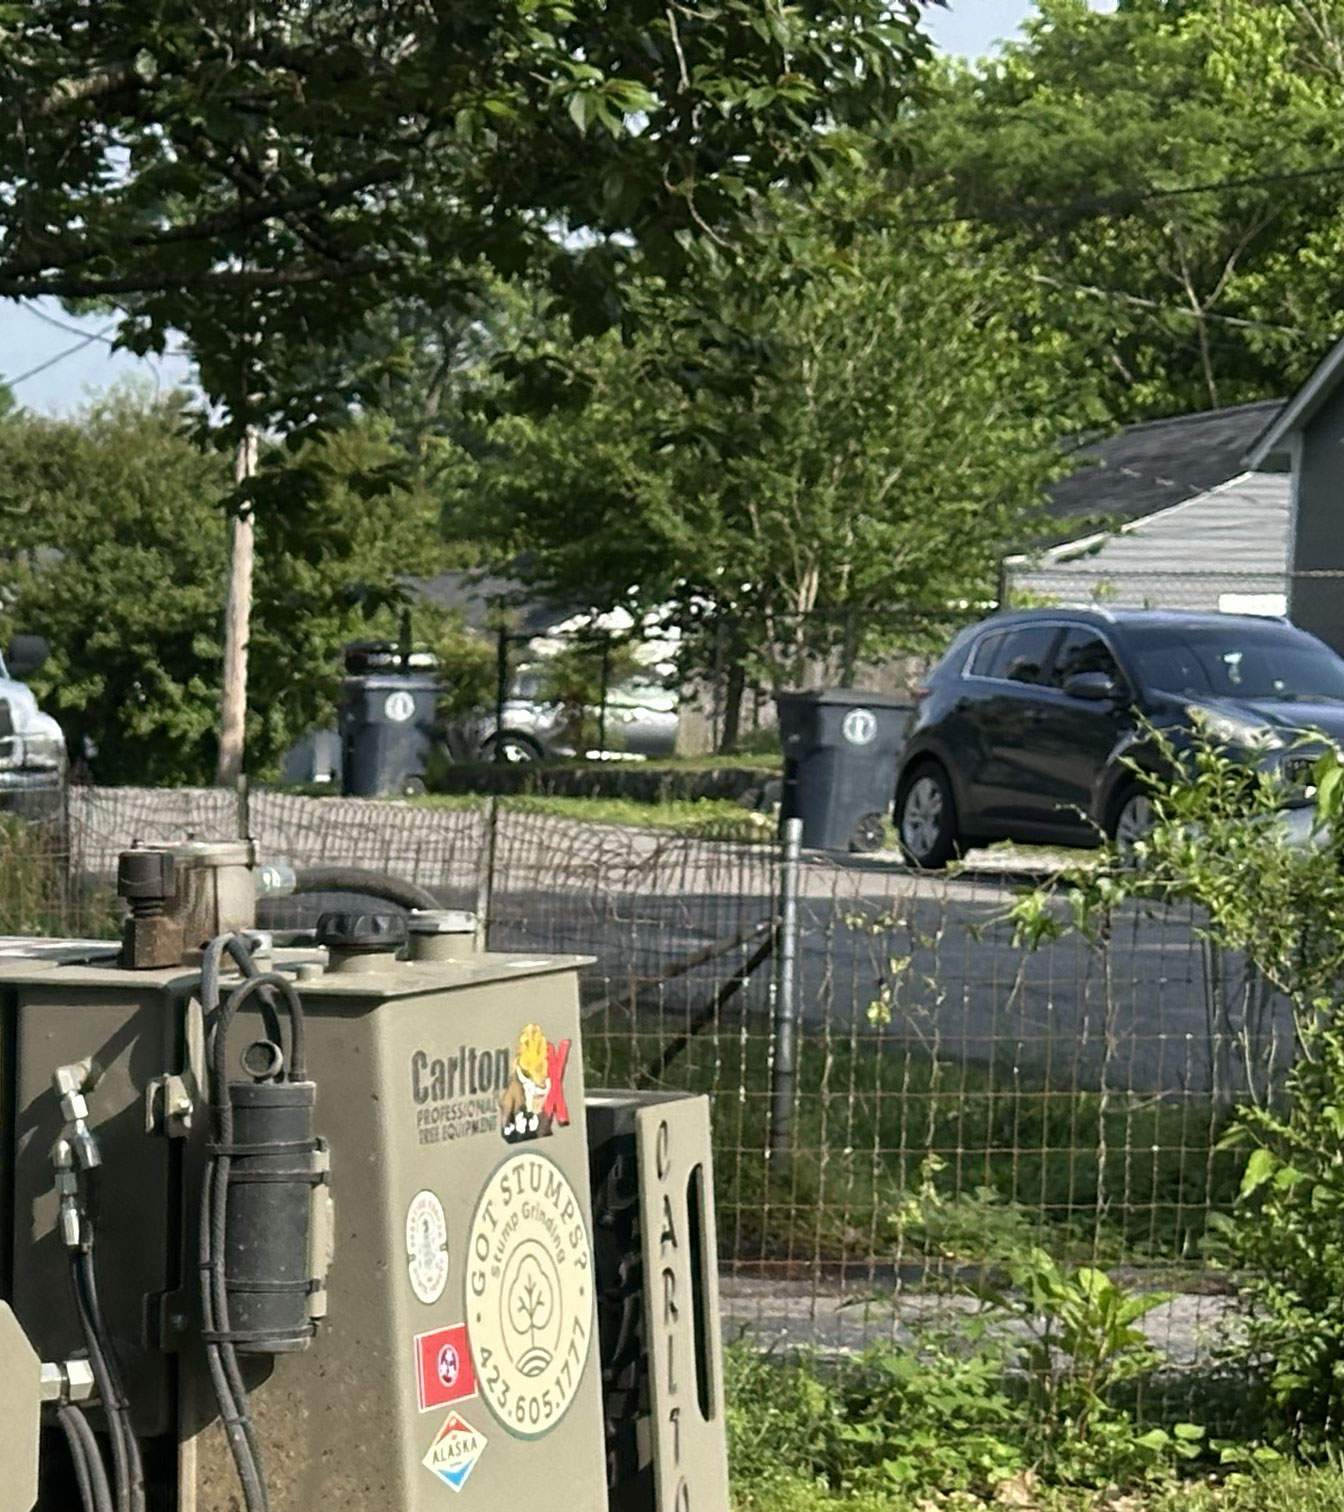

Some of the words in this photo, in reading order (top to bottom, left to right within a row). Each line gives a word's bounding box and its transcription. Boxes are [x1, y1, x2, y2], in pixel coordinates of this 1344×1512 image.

[411, 1045, 510, 1105] Carlton
[416, 1098, 499, 1128] PROFESSIONAL
[419, 1123, 441, 1145] TREE
[442, 1114, 498, 1142] EQUIPMENT
[471, 1199, 499, 1297] GOT
[499, 1160, 588, 1270] STUMPS?
[521, 1200, 566, 1264] Grinding
[480, 1314, 586, 1425] 423.605.1777
[432, 1436, 478, 1466] ALASKA
